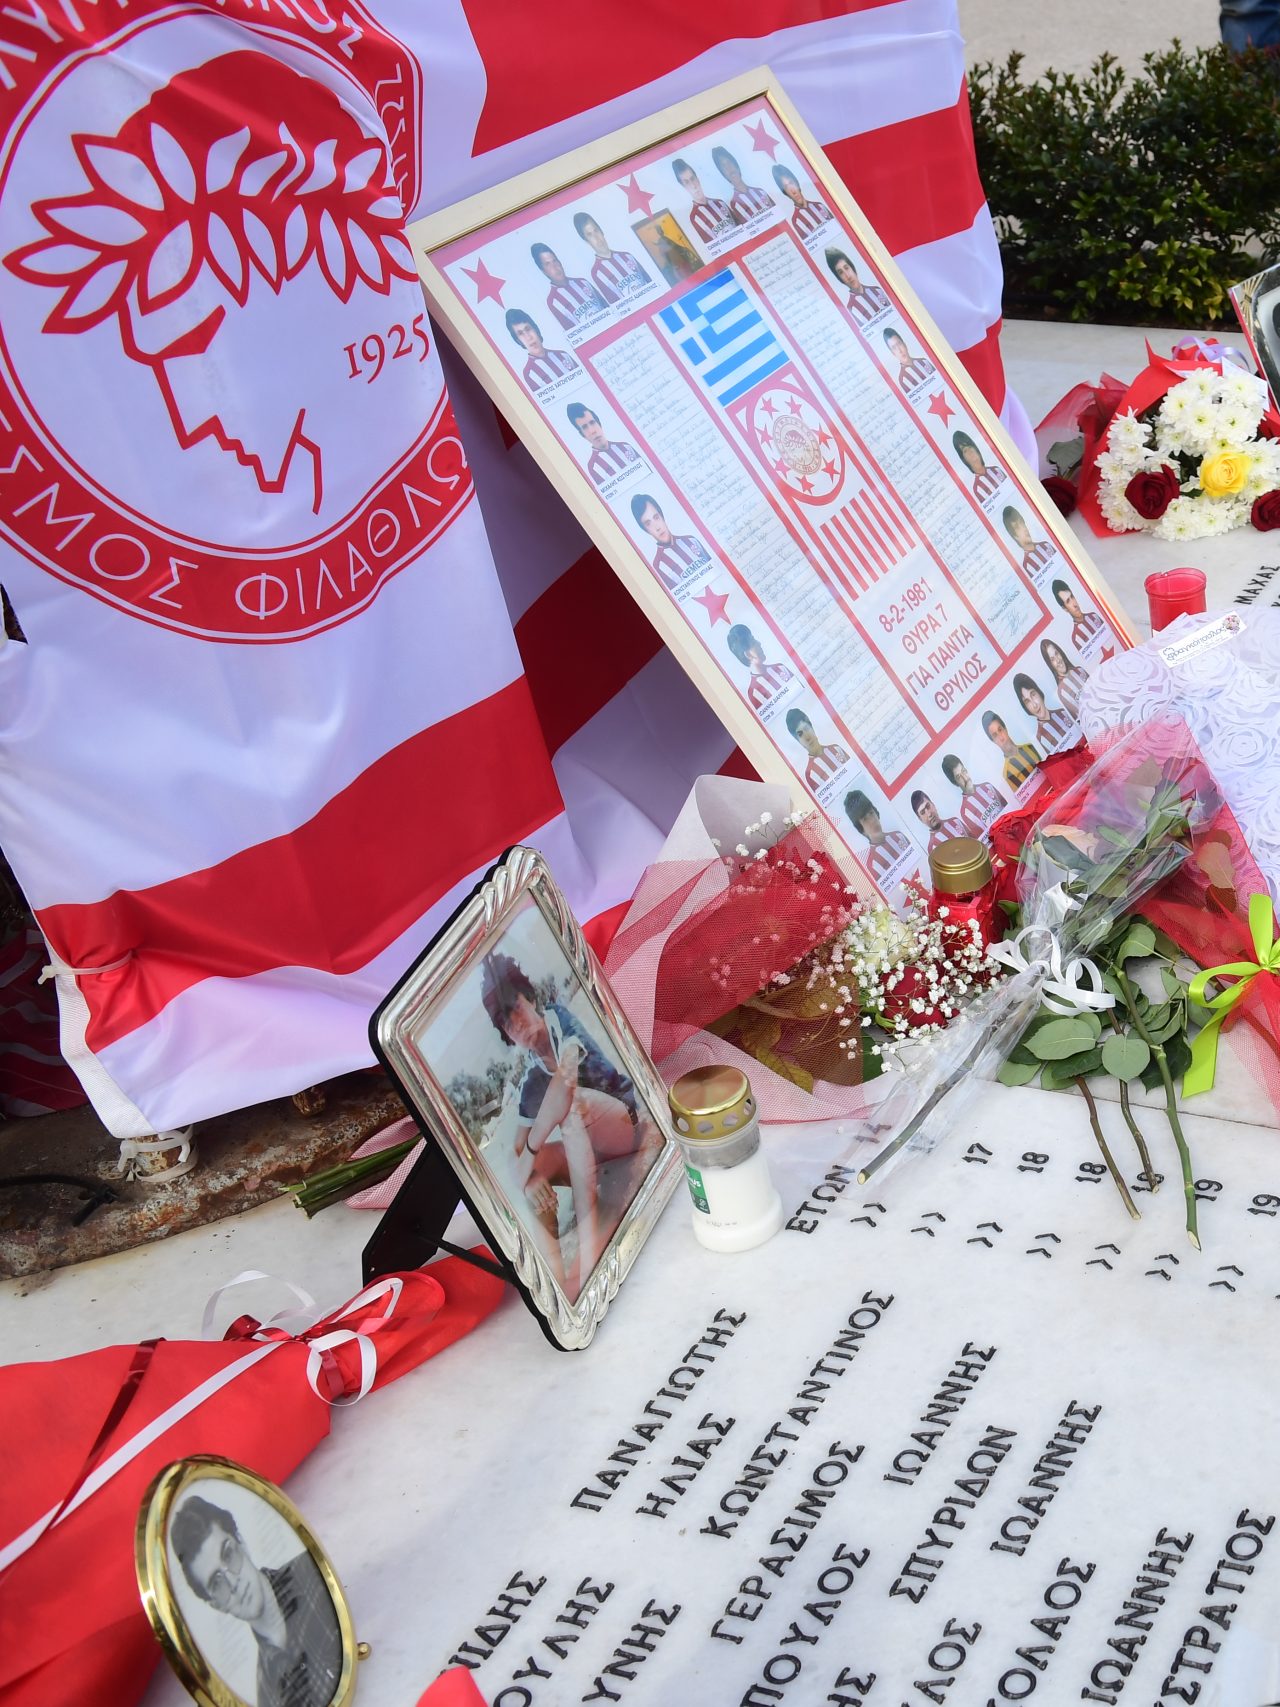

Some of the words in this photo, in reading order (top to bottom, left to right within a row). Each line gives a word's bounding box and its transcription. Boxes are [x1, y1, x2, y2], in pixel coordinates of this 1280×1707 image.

[344, 312, 429, 384] 1925
[236, 436, 468, 620] ΦΙΛΑΘΛΩ
[879, 577, 934, 633] 8-2-1981
[1232, 565, 1280, 606] ΜΑΧΑΣ
[902, 614, 942, 654] ΘΥΡΑ
[939, 603, 950, 622] 7
[905, 665, 934, 696] ΓΙΑ
[928, 624, 975, 674] ΠΑΝΤΑ
[934, 652, 987, 711] ΘΡΥΛΟΣ
[570, 1308, 747, 1512] ΠΑΝΑΓΙΩΤΗΣ
[785, 1164, 856, 1234] ΕΤΩΝ
[700, 1290, 894, 1539] ΚΩΝΣΤΑΝΤΙΝΟΣ
[962, 1143, 993, 1164] 17
[711, 1441, 865, 1645] ΓΕΡΑΣΙΜΟΣ
[1017, 1152, 1049, 1173] 18
[883, 1342, 997, 1485] ΙΩΑΝΝΗΣ
[1075, 1161, 1108, 1184] 18
[635, 1413, 736, 1519] ΗΛΙΑΣ
[889, 1425, 1017, 1604] ΣΠΥΡΙΔΩΝ
[990, 1400, 1102, 1557] ΙΩΑΝΝΗΣ
[987, 1557, 1096, 1707] ΟΛΑΟΣ
[1081, 1527, 1194, 1706] ΙΩΑΝΝΗΣ
[1154, 1508, 1276, 1707] ΣΤΡΑΤΙΟΣ
